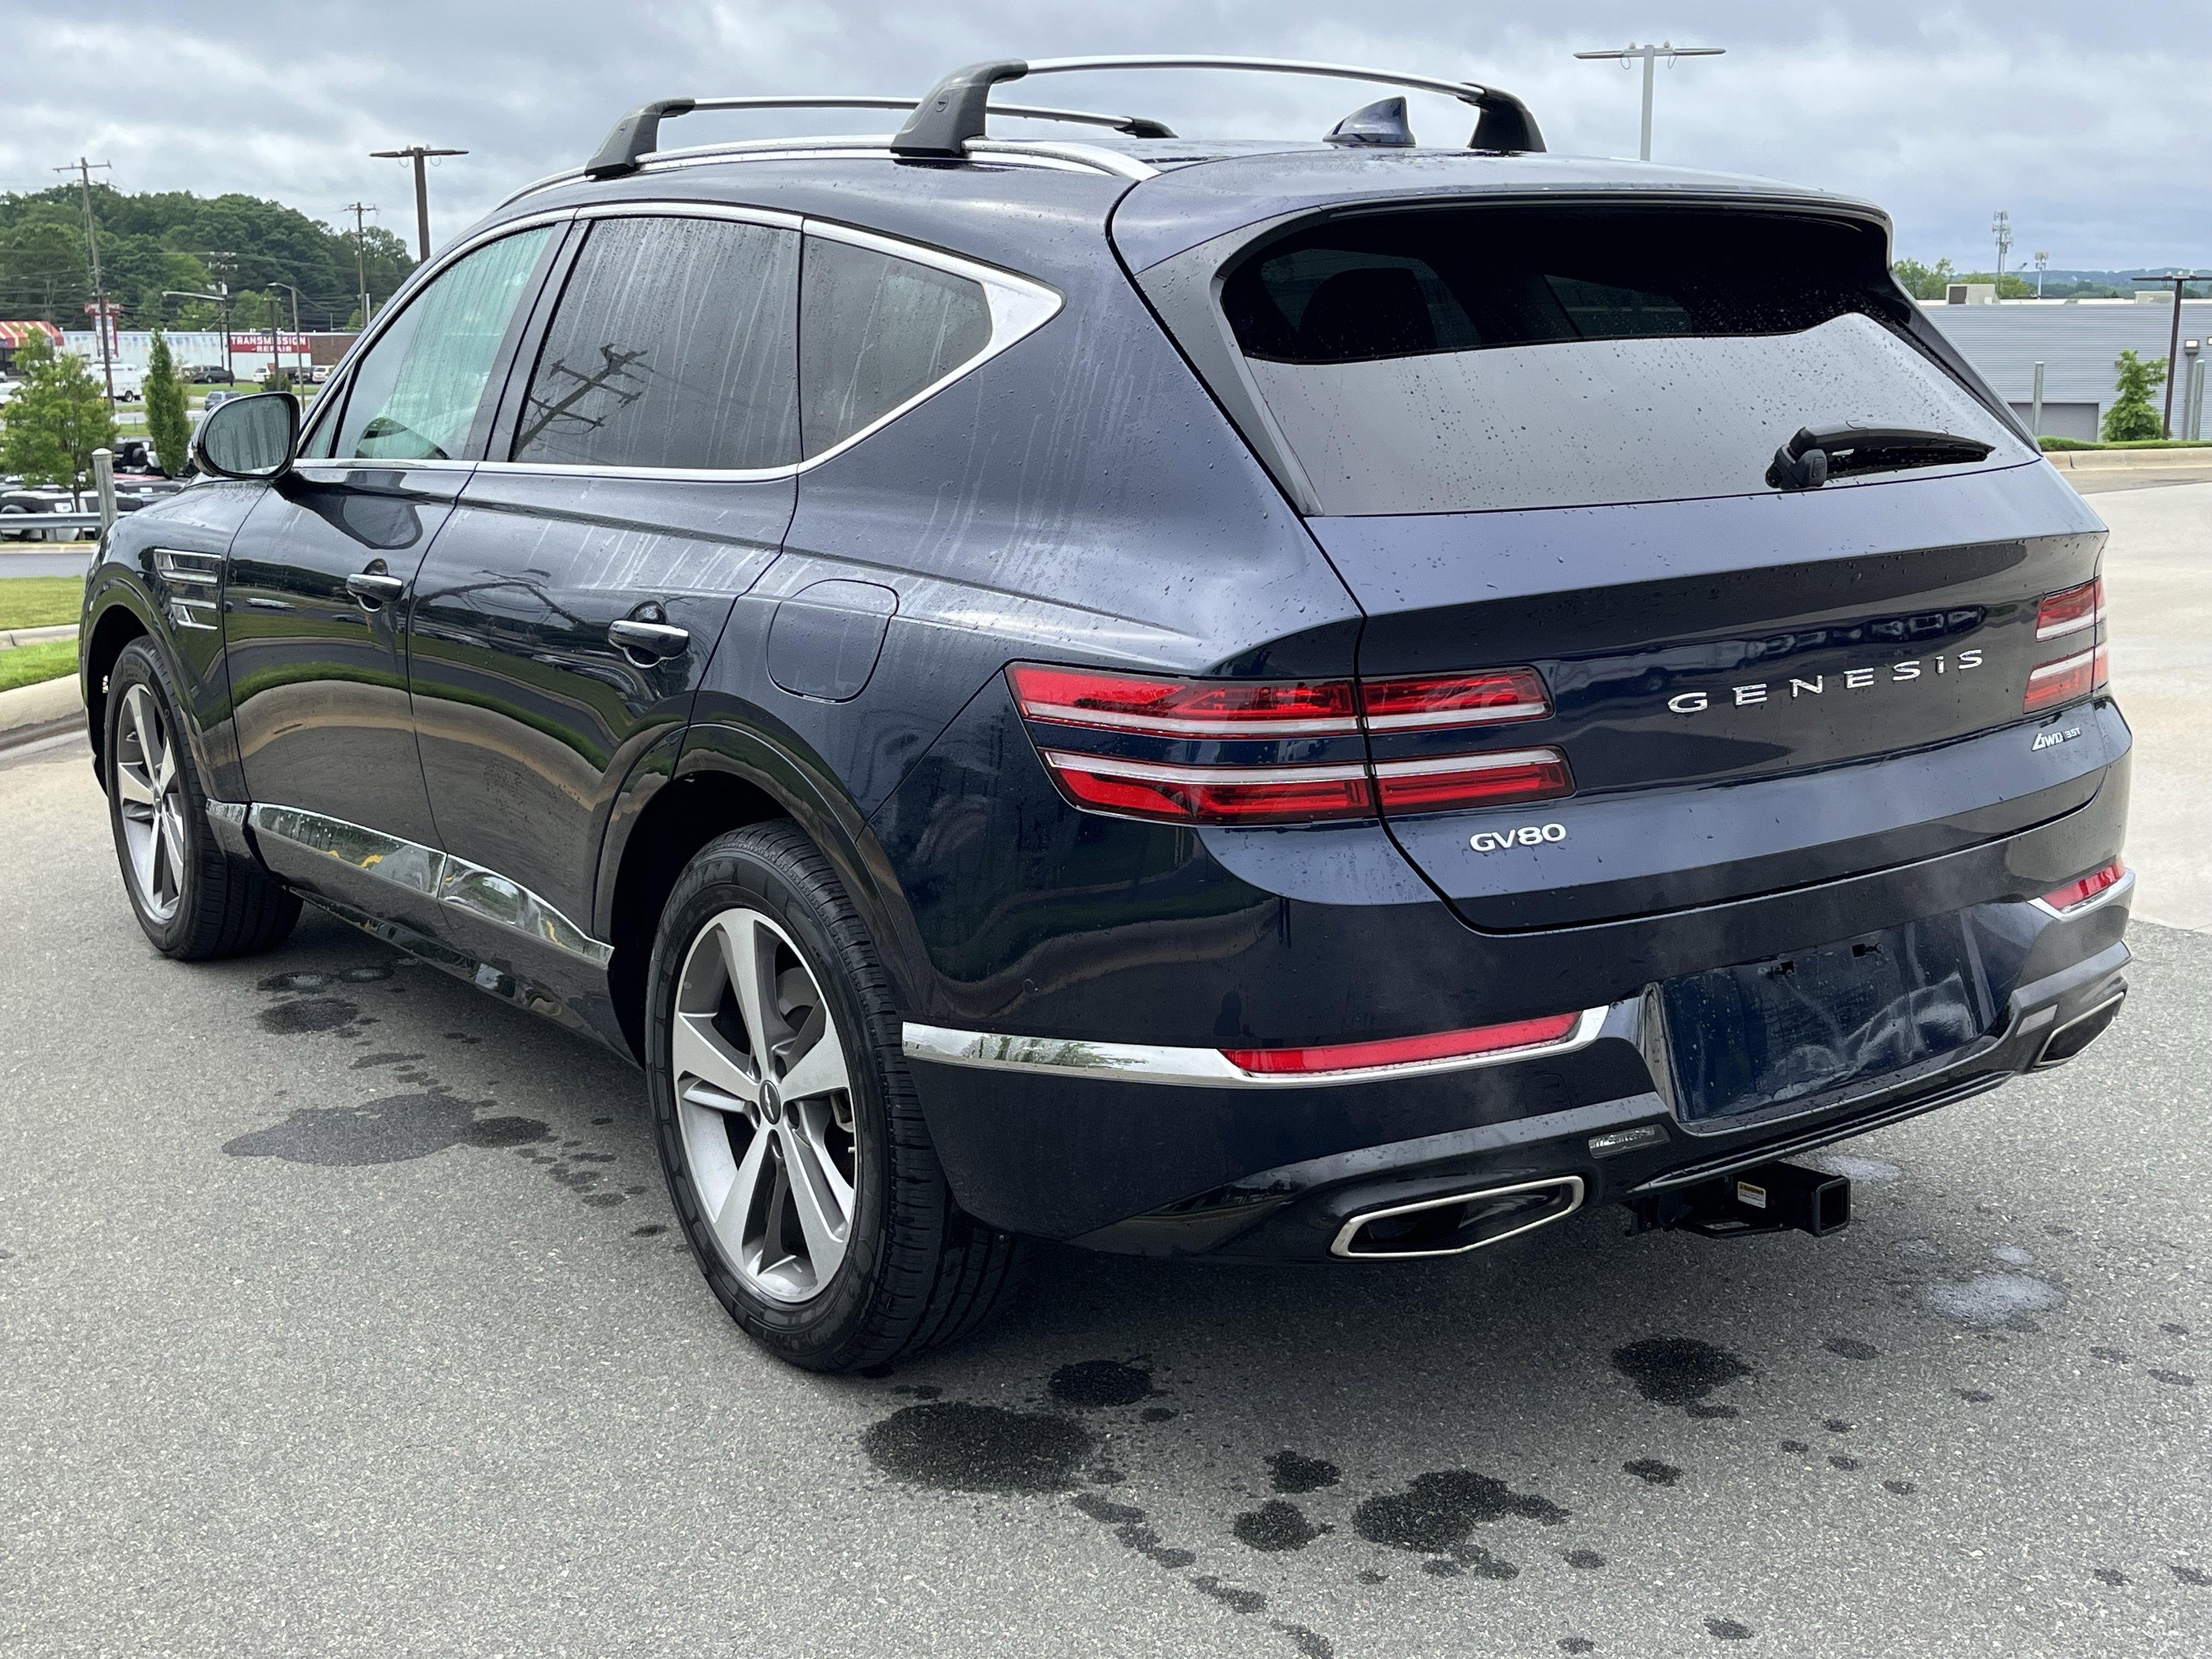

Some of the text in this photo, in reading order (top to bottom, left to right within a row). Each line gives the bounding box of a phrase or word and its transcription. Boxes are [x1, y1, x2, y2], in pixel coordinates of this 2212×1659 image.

[231, 336, 306, 345] TRANSMISSION
[1667, 649, 1983, 713] GENESIS
[1470, 823, 1566, 851] GV80
